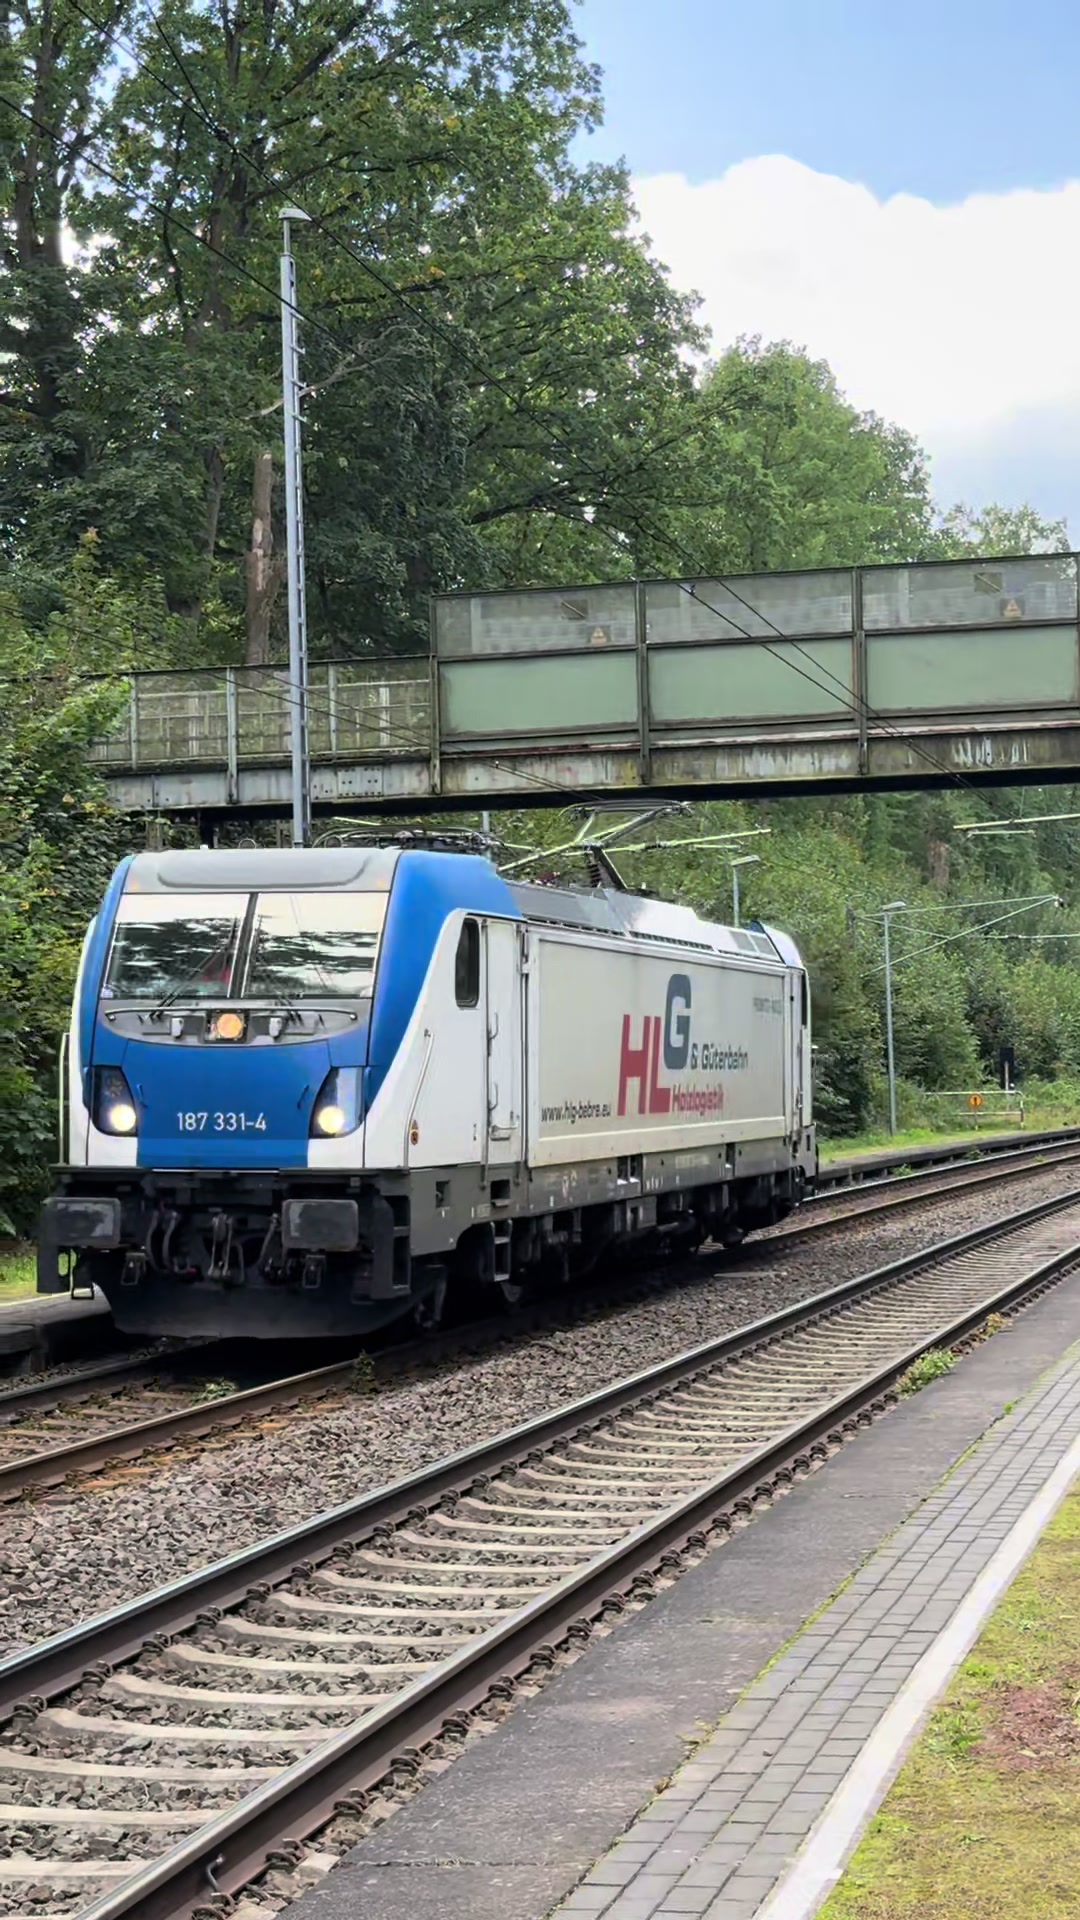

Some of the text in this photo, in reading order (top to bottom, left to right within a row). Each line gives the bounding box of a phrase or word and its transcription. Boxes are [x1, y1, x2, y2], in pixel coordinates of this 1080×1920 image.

[690, 1043, 749, 1070] & Güterbahn
[177, 1112, 267, 1131] 187 331-4
